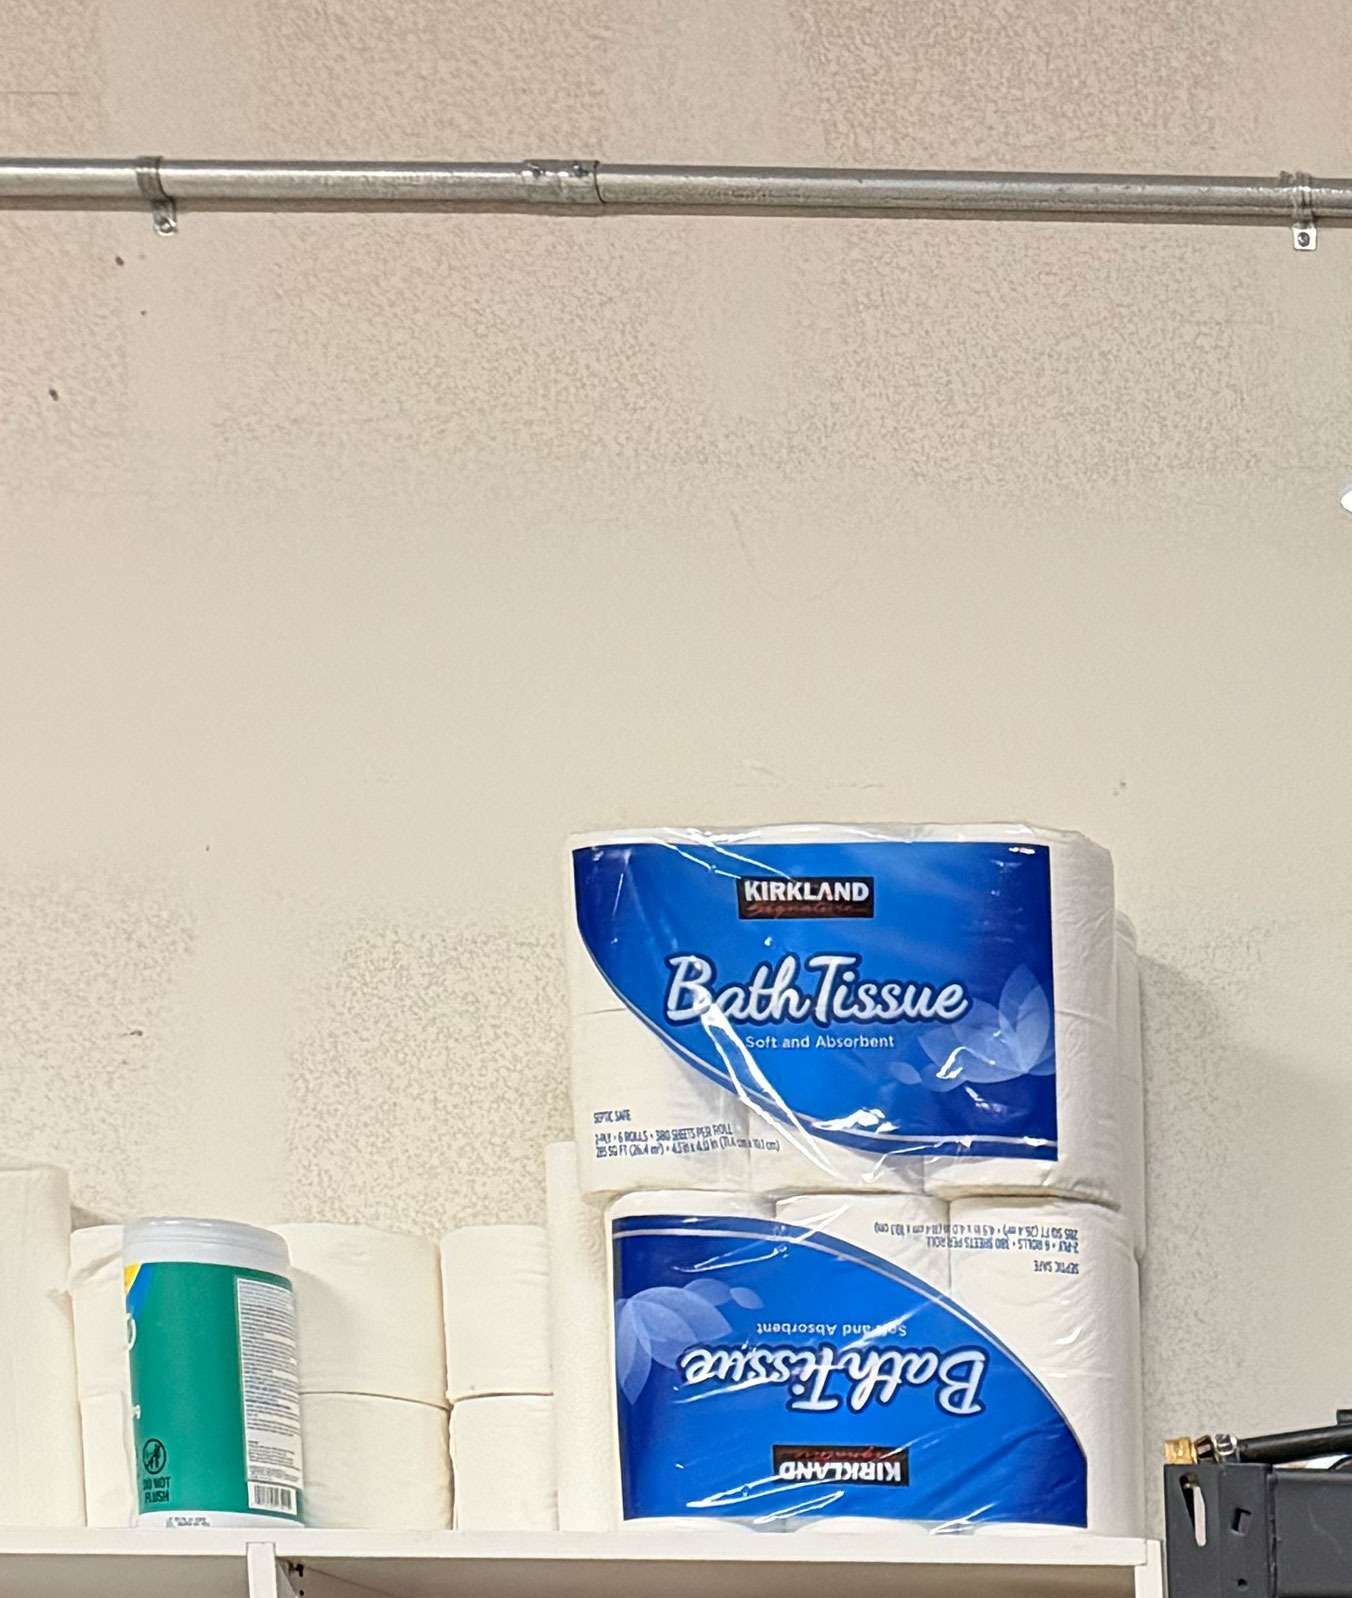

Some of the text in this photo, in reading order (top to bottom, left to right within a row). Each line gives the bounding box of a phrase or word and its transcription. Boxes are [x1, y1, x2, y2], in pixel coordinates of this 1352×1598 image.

[744, 880, 870, 902] KIRKLAND
[666, 953, 969, 1023] Bath Tissue
[745, 1034, 894, 1049] Soft and Absorbent
[624, 1130, 648, 1143] ROLLS
[696, 1126, 712, 1139] PER
[713, 1124, 733, 1136] ROLL
[947, 1236, 963, 1249] PER
[756, 1322, 837, 1338] Absorbent
[842, 1323, 872, 1337] and
[681, 1347, 985, 1414] Bath Tissue
[778, 1461, 900, 1482] KIRKLAND
[144, 1489, 170, 1503] FLUSH
